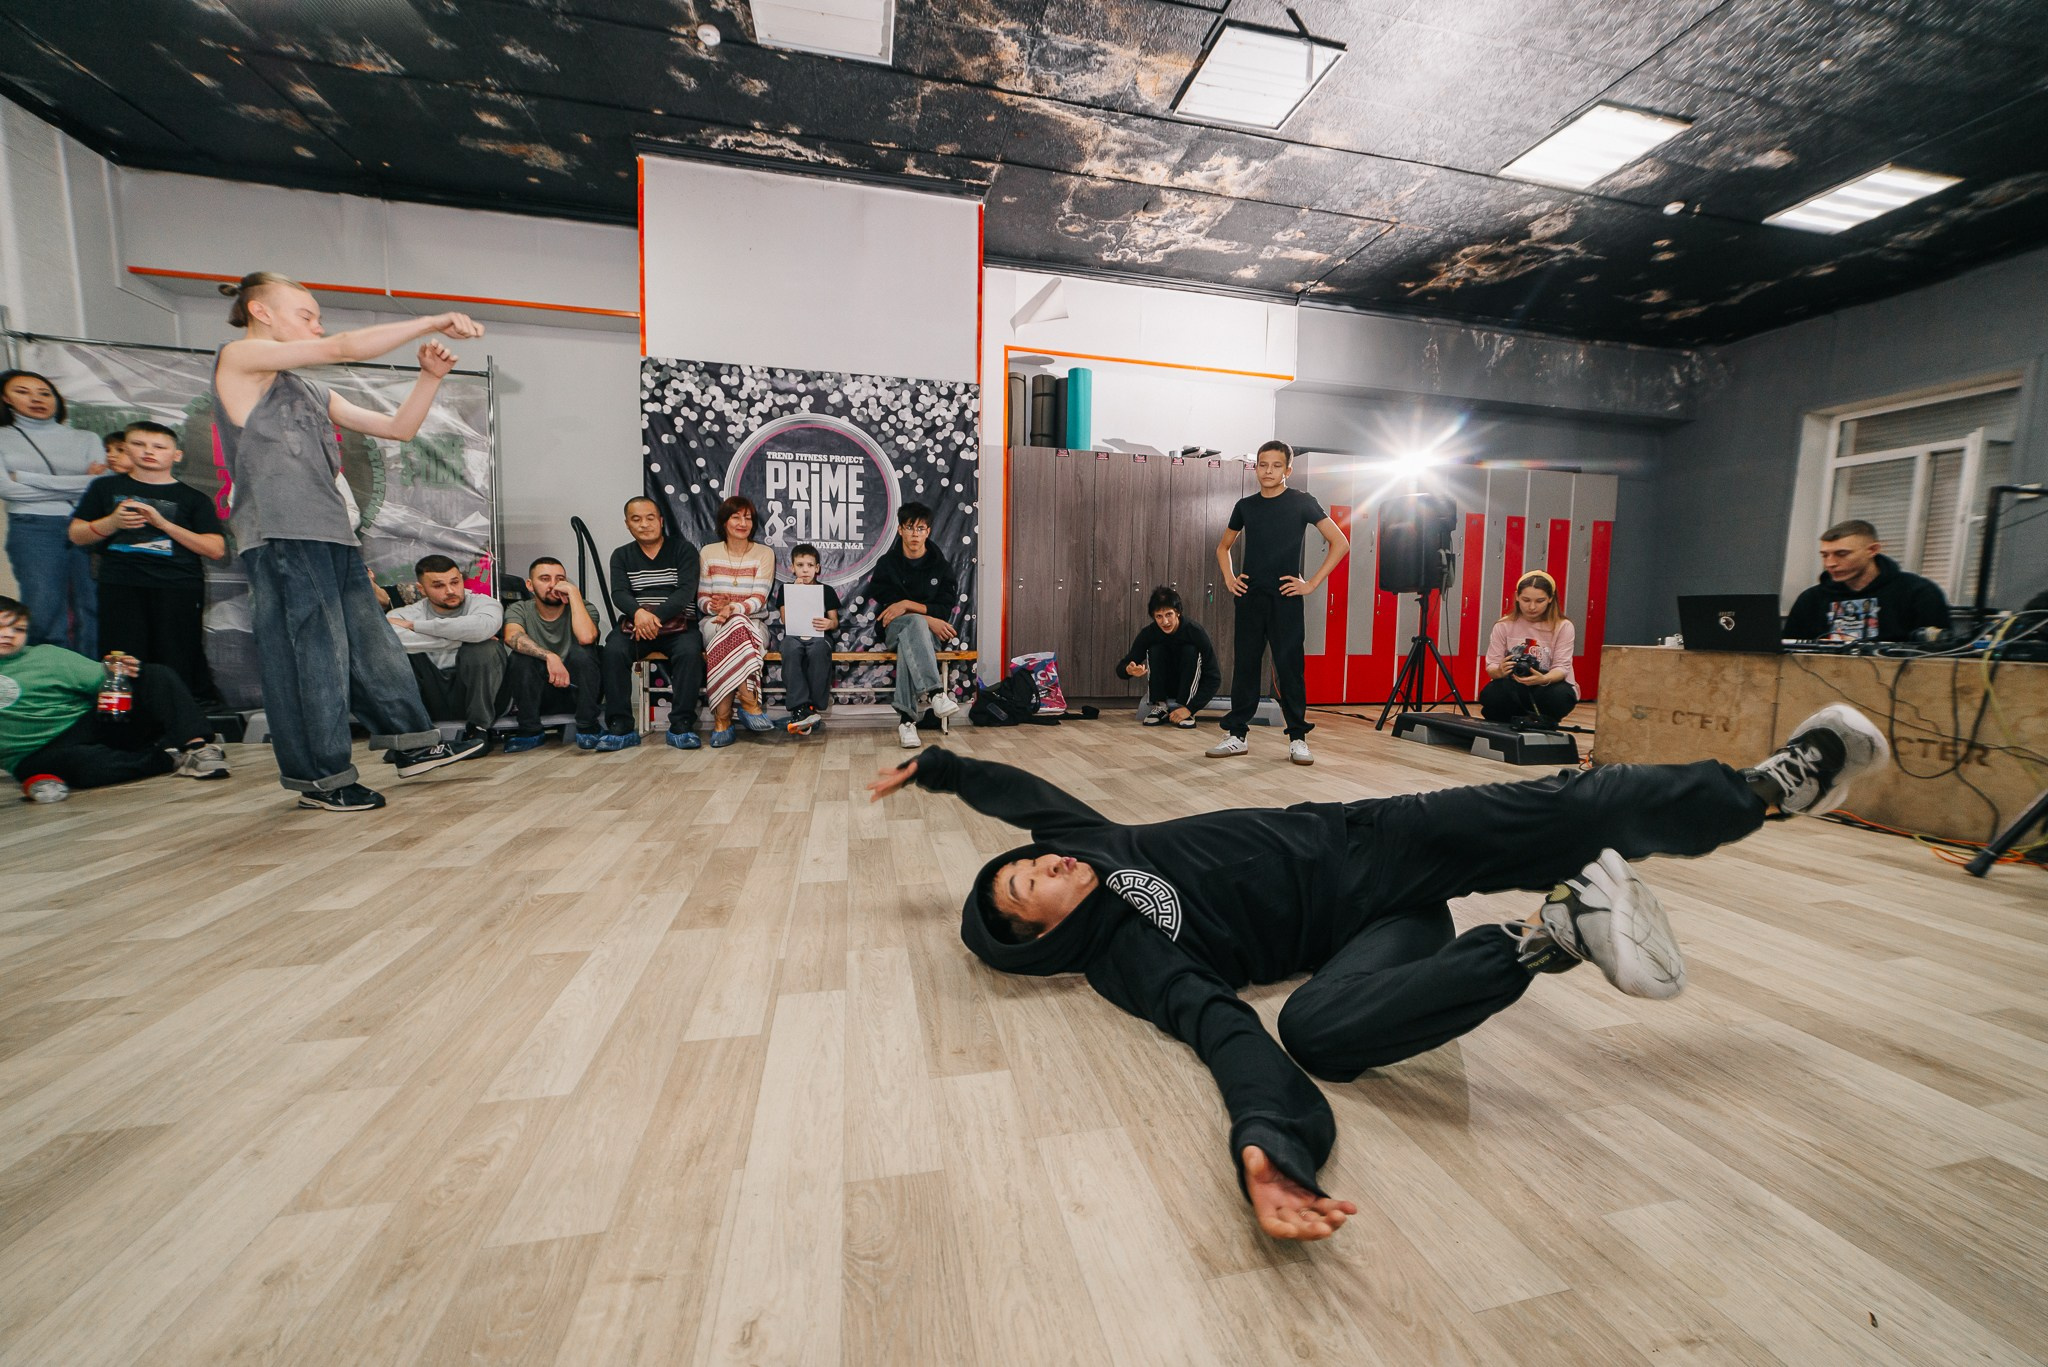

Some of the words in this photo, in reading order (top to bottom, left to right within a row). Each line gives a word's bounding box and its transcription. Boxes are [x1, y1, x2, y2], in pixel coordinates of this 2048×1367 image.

[766, 451, 794, 460] TREND
[795, 453, 828, 462] FITNESS
[829, 454, 864, 464] PROJECT
[811, 541, 843, 550] MAYER
[844, 542, 864, 550] N&A
